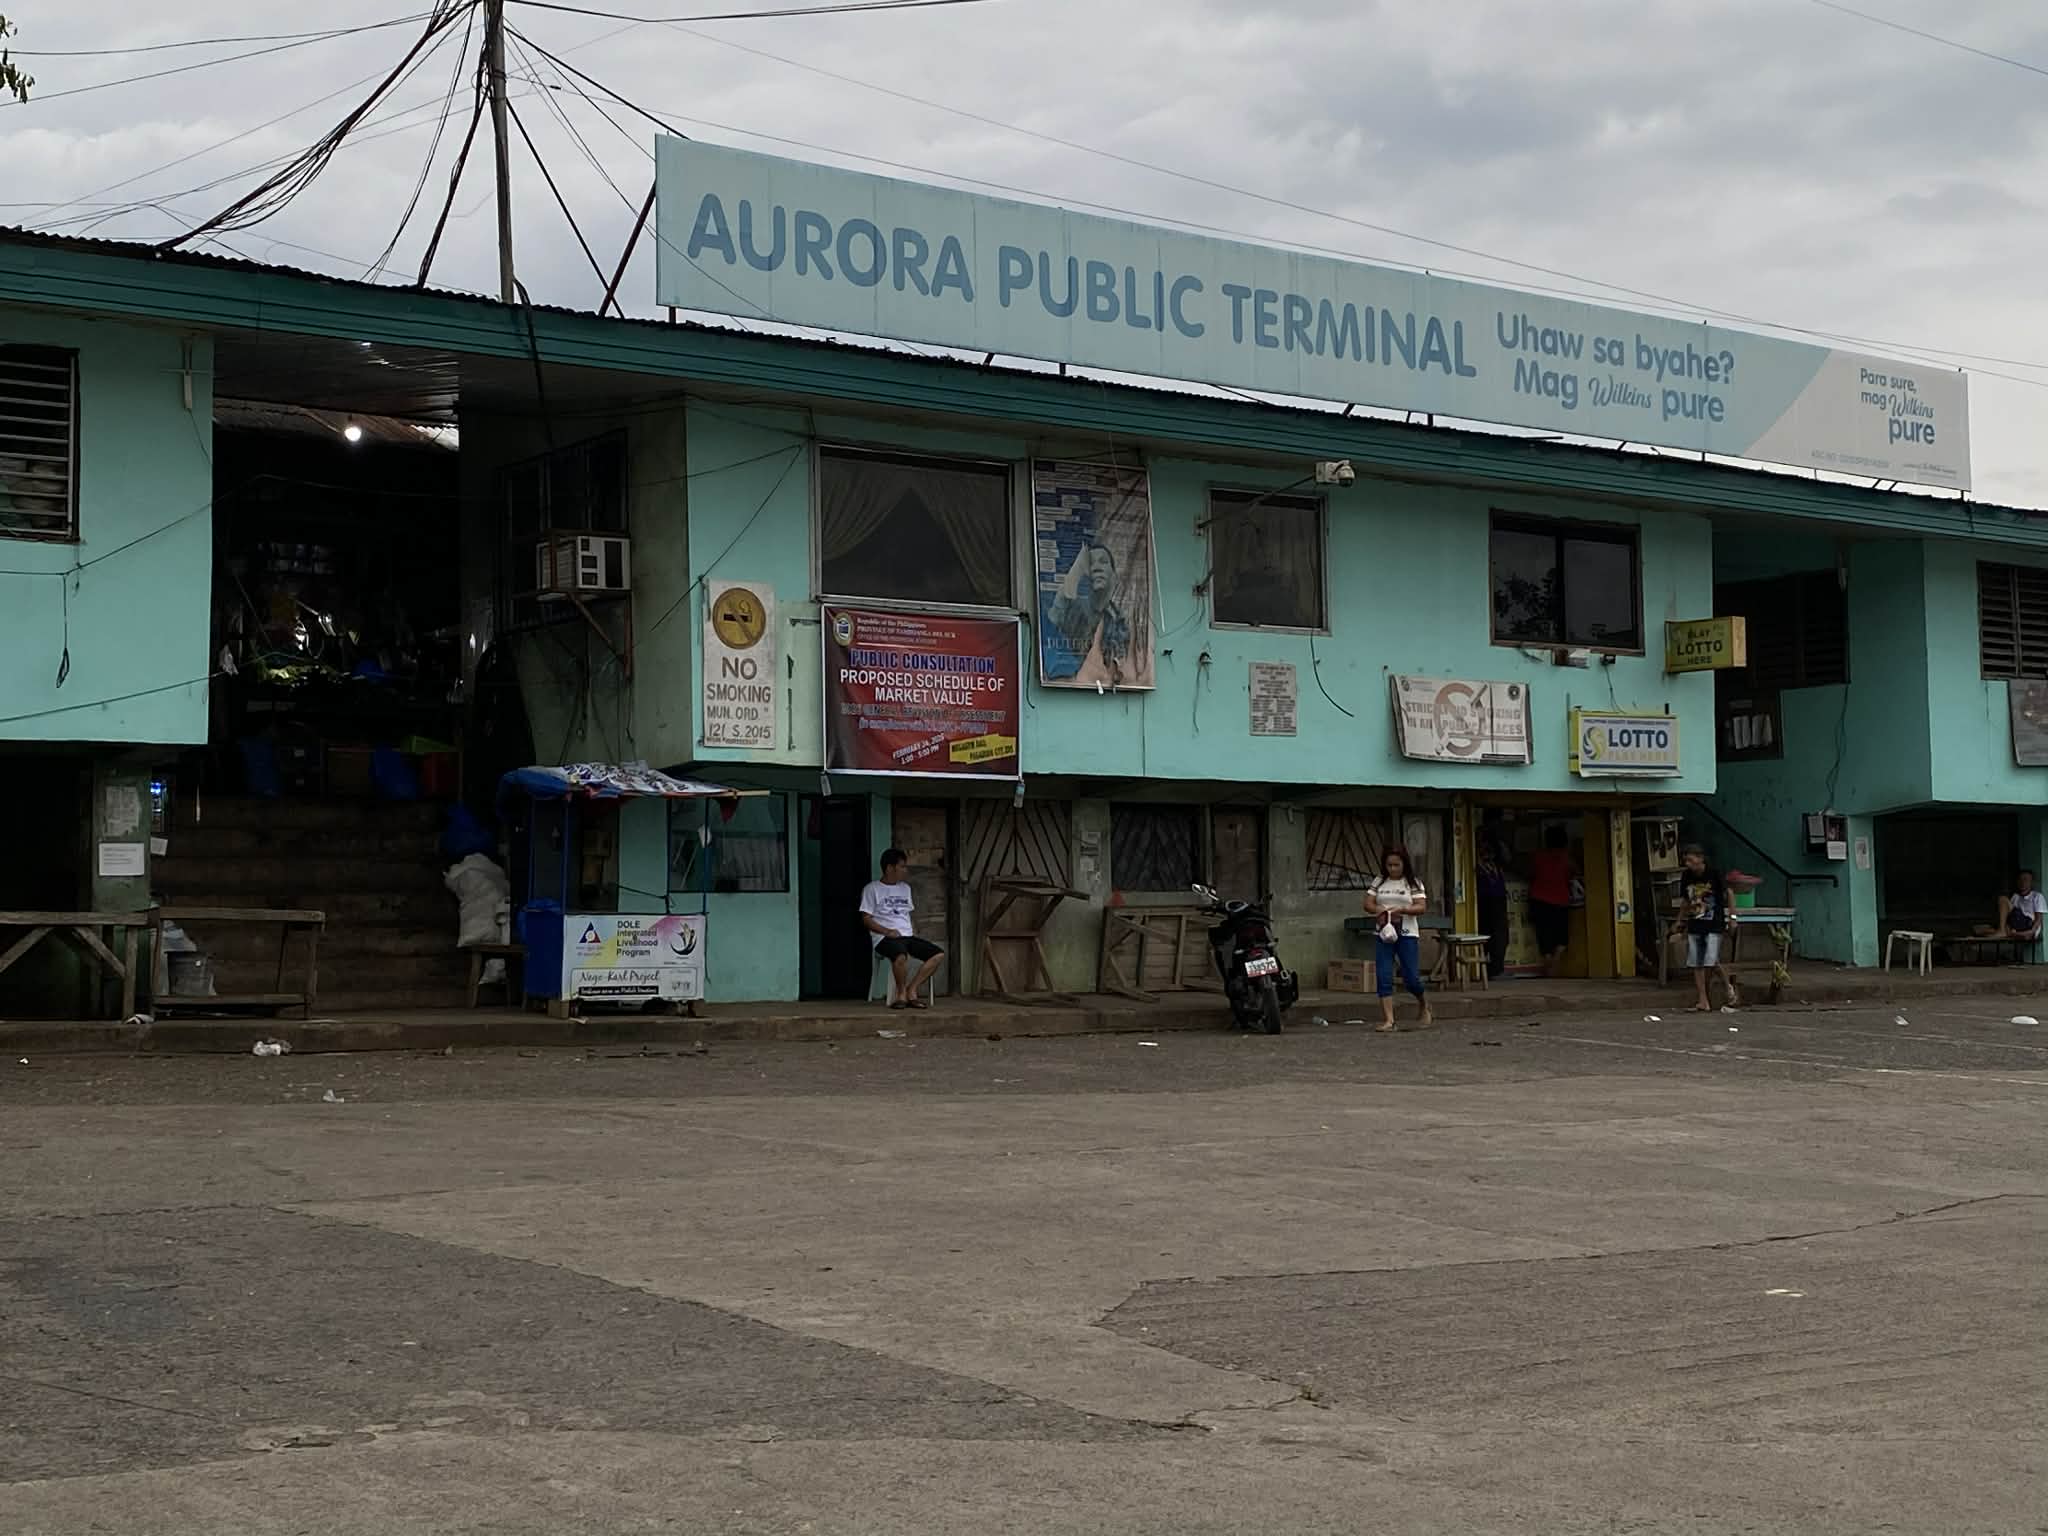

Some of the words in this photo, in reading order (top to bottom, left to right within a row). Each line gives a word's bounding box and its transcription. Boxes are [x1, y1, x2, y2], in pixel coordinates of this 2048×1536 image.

[687, 192, 974, 303] AURORA
[998, 245, 1205, 338] PUBLIC
[1222, 284, 1477, 378] TERMINAL
[1496, 311, 1584, 361] Uhaw
[1592, 336, 1625, 367] sa
[1635, 333, 1735, 385] byahe?
[1512, 357, 1578, 410] Mag
[1587, 374, 1652, 410] Wilkins
[1661, 388, 1725, 423] pure
[1860, 367, 1888, 387] Para
[1890, 374, 1917, 394] sure,
[1860, 391, 1888, 411] mag
[1888, 392, 1934, 420] Wilkins
[1889, 416, 1935, 445] pure
[1677, 640, 1722, 656] LOTTO
[722, 656, 757, 681] NO
[849, 648, 898, 668] PUBLIC
[902, 653, 996, 674] CONSULTATION
[1688, 655, 1712, 665] HERE
[840, 669, 912, 688] PROPOSED
[915, 673, 984, 691] SCHEDULE
[987, 678, 1006, 692] OF
[706, 683, 771, 703] SMOKING
[875, 687, 928, 704] MARKET
[932, 690, 973, 706] VALUE
[1608, 728, 1668, 748] LOTTO
[617, 920, 641, 929] DOLE
[617, 929, 657, 939] Integrated
[616, 948, 651, 958] Program
